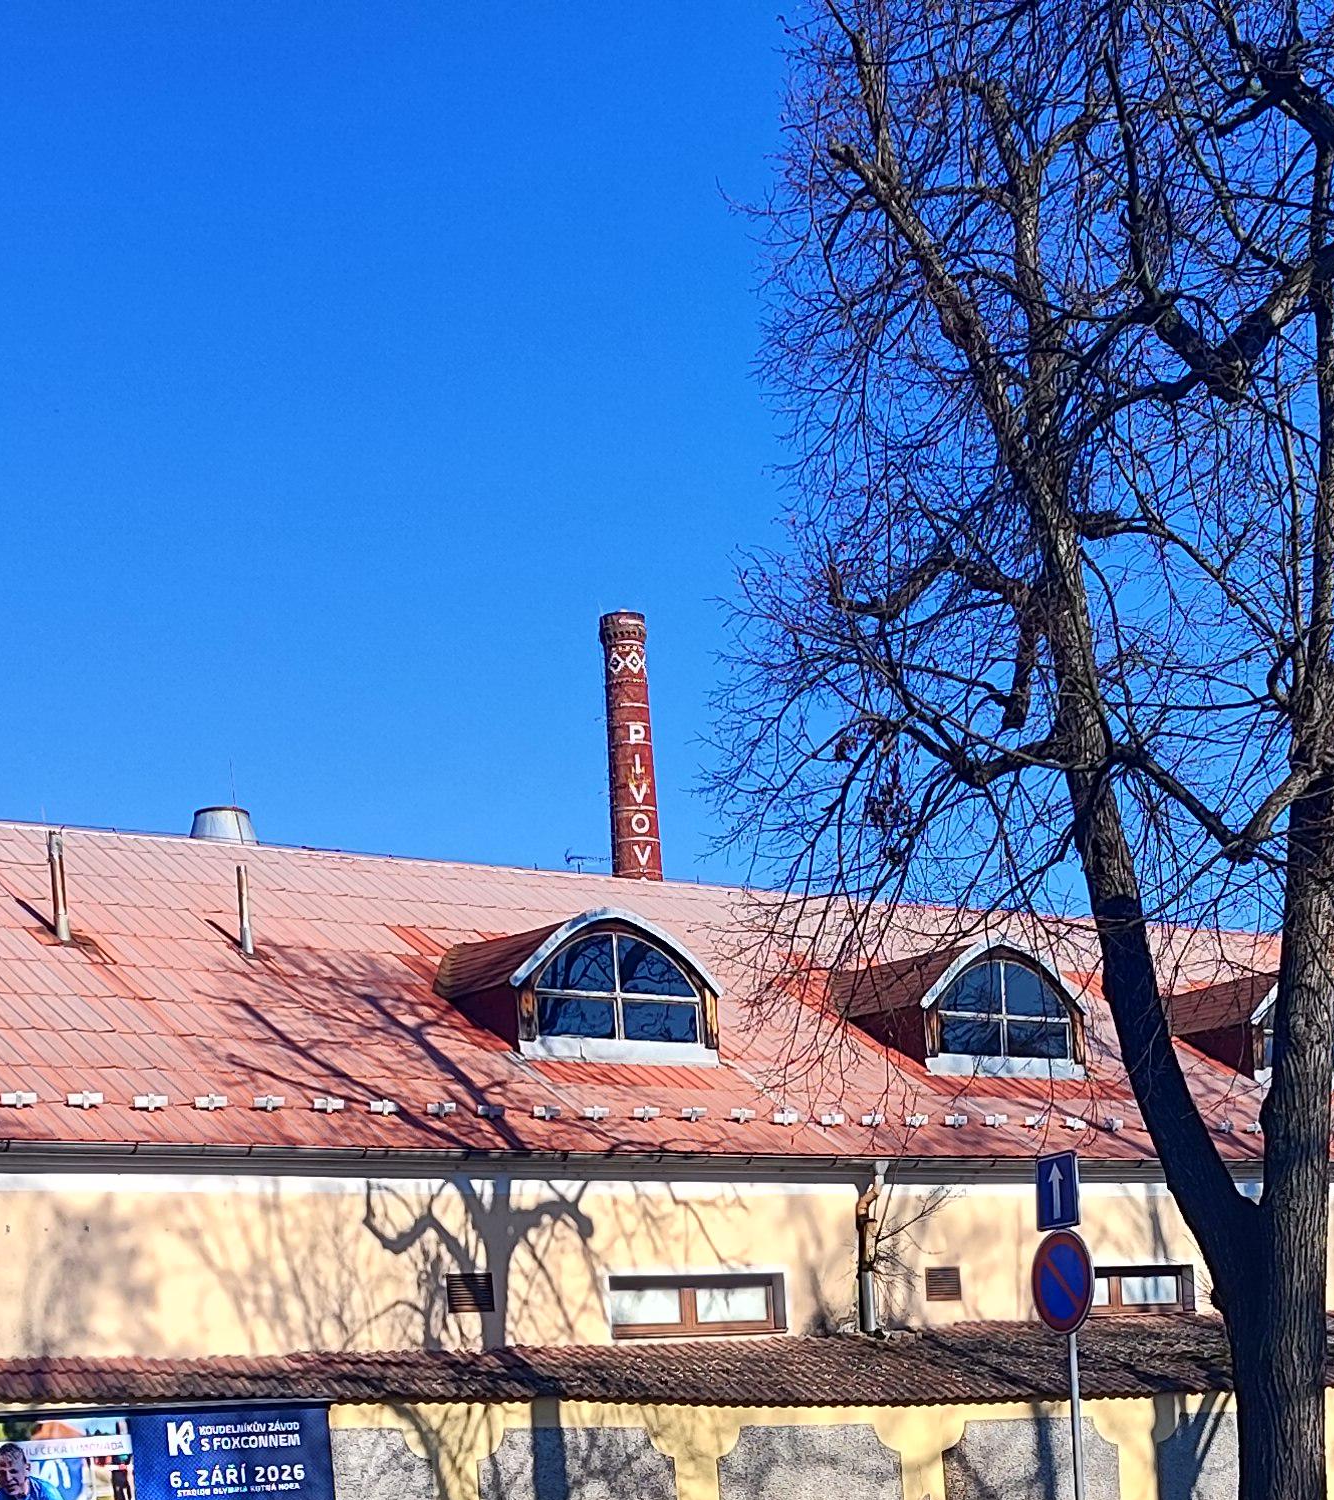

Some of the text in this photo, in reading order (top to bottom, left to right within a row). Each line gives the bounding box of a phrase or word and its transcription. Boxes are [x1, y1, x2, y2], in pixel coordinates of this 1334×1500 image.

[268, 1418, 300, 1432] ZÁVOD
[200, 1434, 301, 1452] S FOXCONNEM
[169, 1463, 306, 1488] 6. ZÁŘÍ 2026
